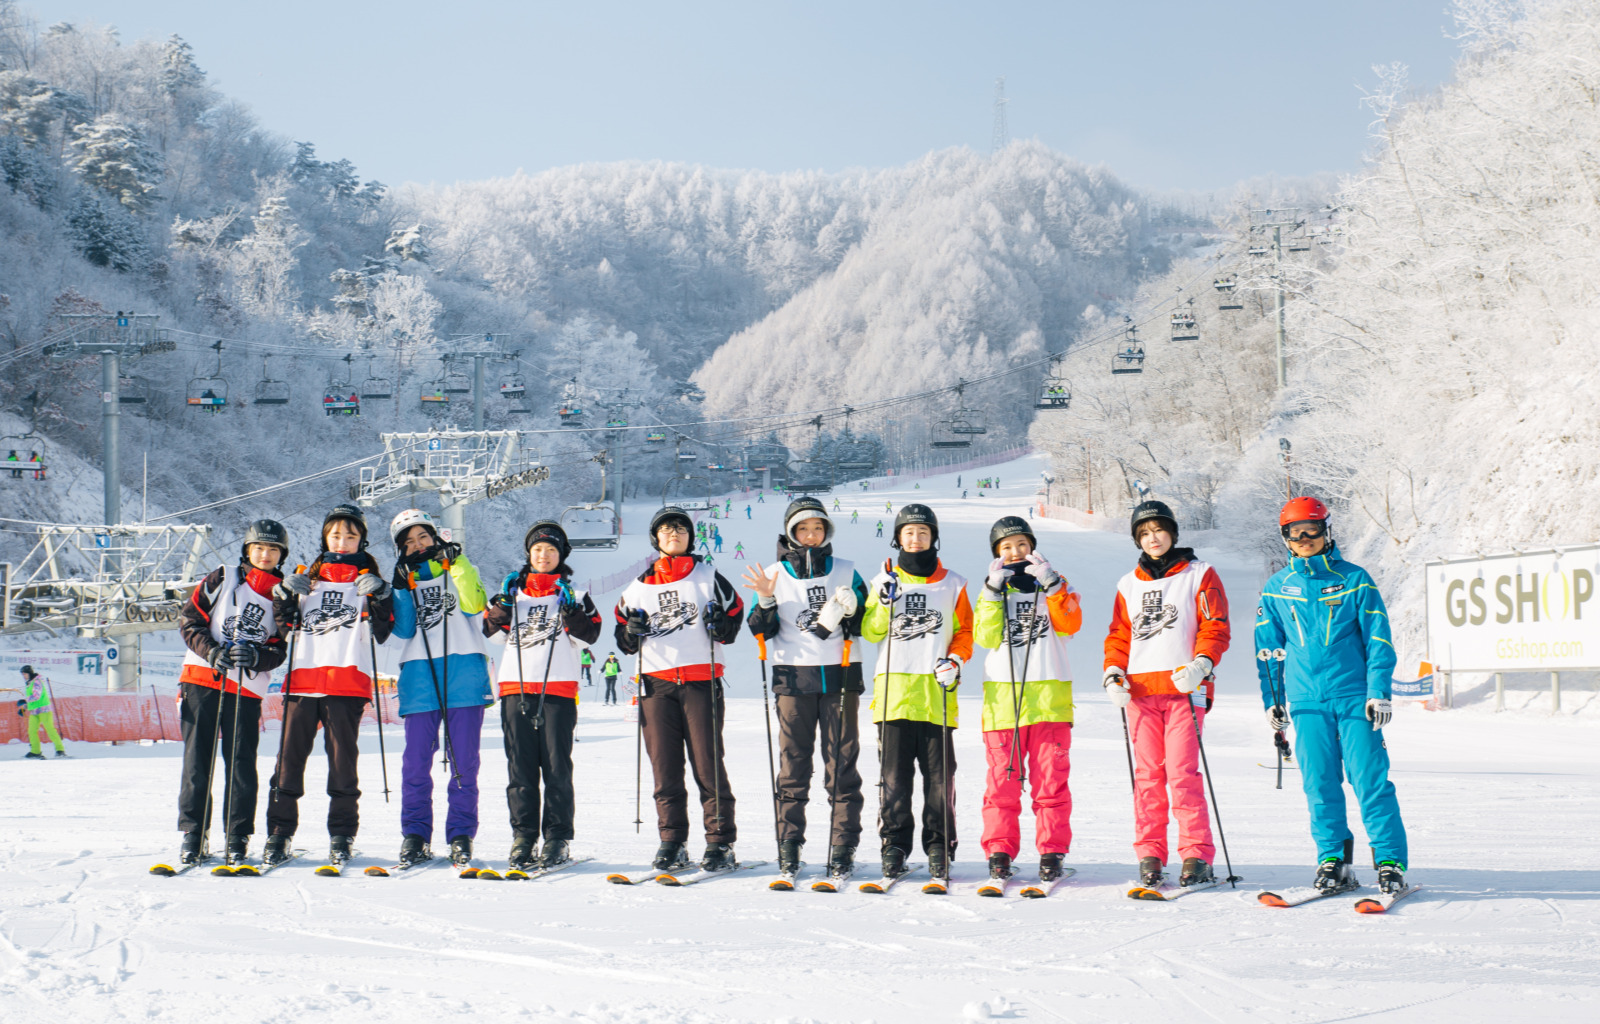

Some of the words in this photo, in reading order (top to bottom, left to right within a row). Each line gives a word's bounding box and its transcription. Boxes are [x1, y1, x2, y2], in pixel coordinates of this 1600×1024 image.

[1446, 578, 1487, 627] GS
[1495, 568, 1594, 625] SHOP
[1496, 636, 1584, 663] GSshop.com
